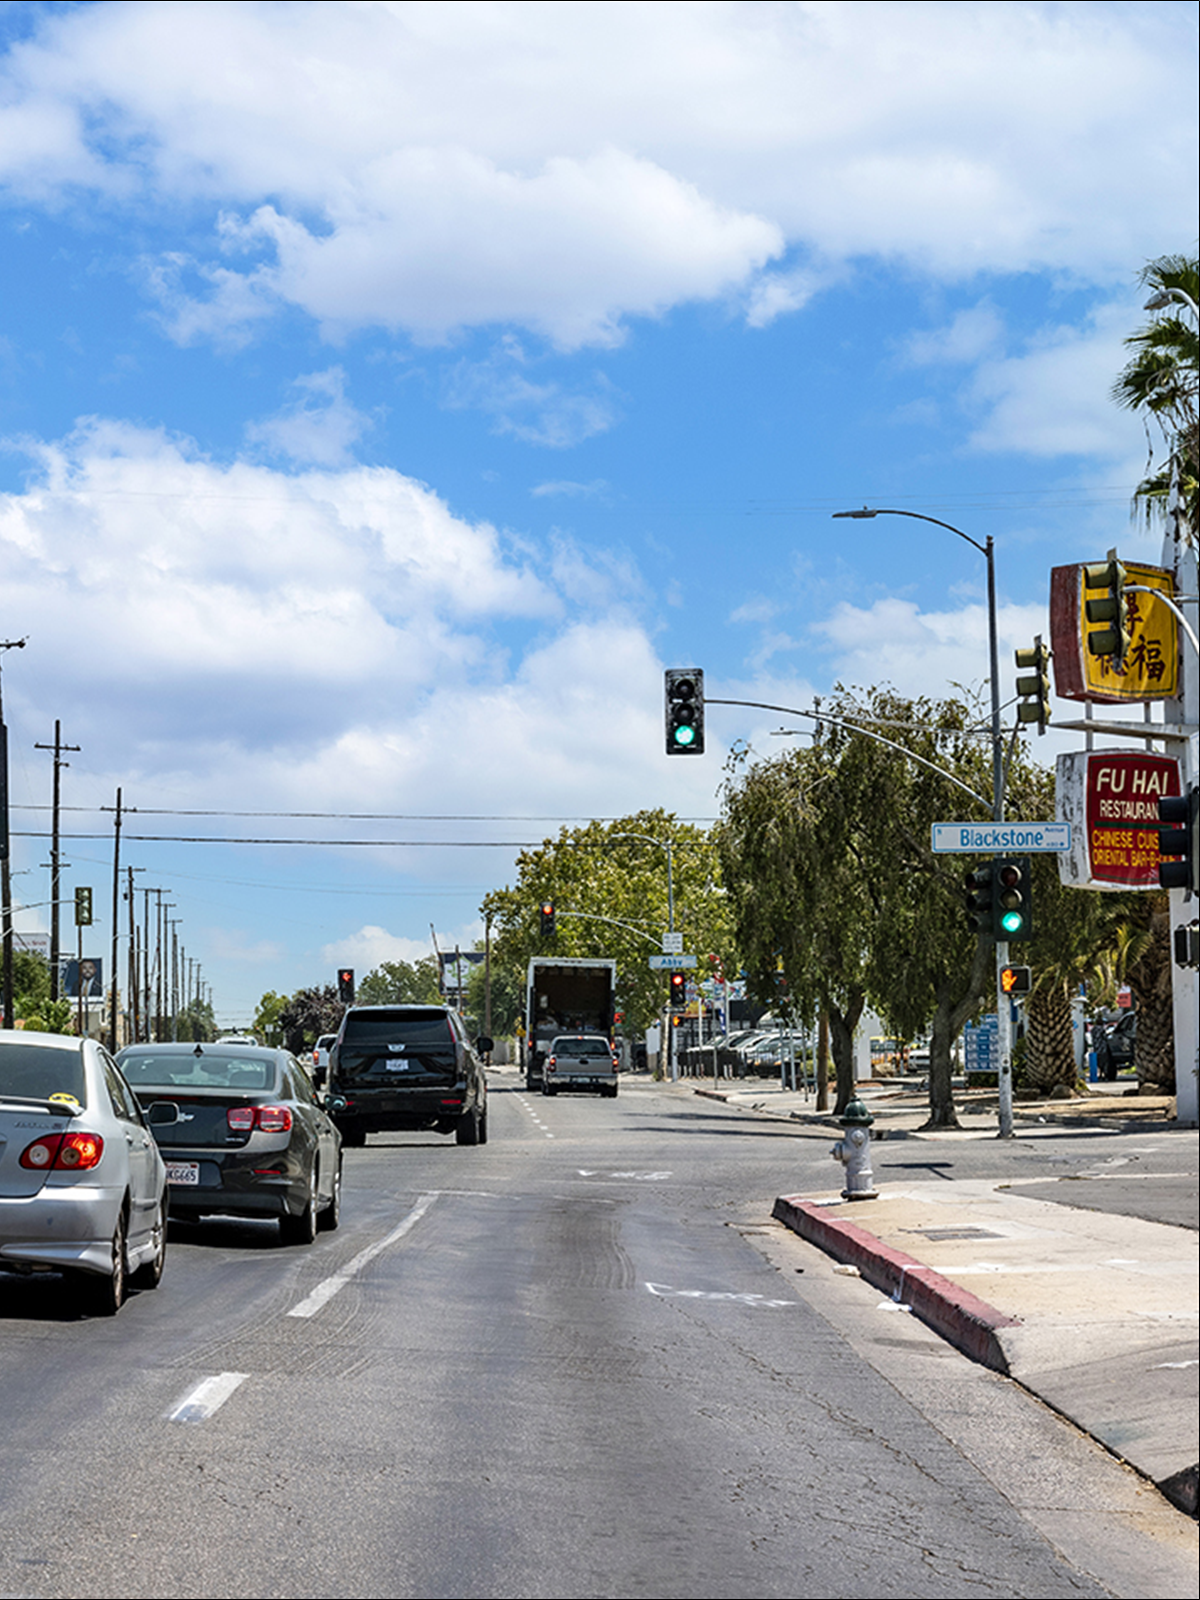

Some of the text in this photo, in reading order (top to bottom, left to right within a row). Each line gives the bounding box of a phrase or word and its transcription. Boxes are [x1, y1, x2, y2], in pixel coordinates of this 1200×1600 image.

[1096, 767, 1169, 796] FU HAI
[1099, 799, 1160, 820] RESTAURAN
[960, 828, 1044, 847] Blackstone
[1091, 829, 1160, 849] CHINESE CUIS
[1091, 848, 1129, 867] ORIENTAL
